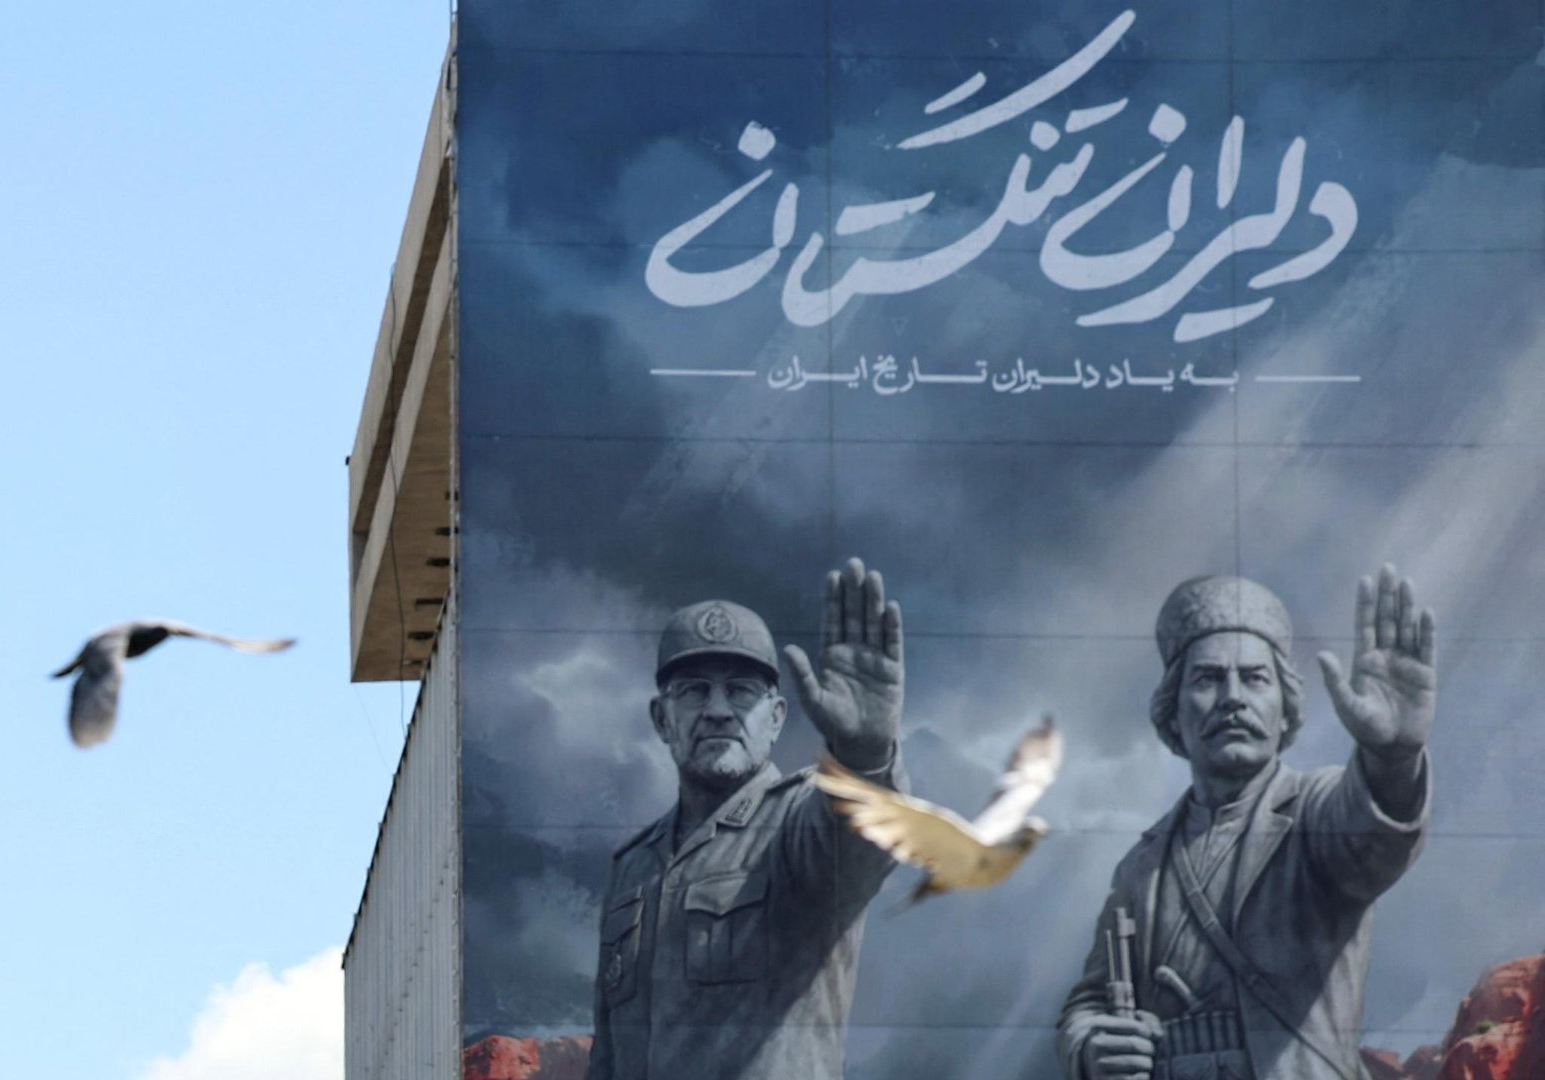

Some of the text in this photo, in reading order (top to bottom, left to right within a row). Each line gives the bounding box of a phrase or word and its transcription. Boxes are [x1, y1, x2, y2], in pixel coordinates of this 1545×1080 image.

[645, 9, 1358, 342] دلیران تنگستان
[767, 354, 1240, 395] به یاد دلیران تاریخ ایران
